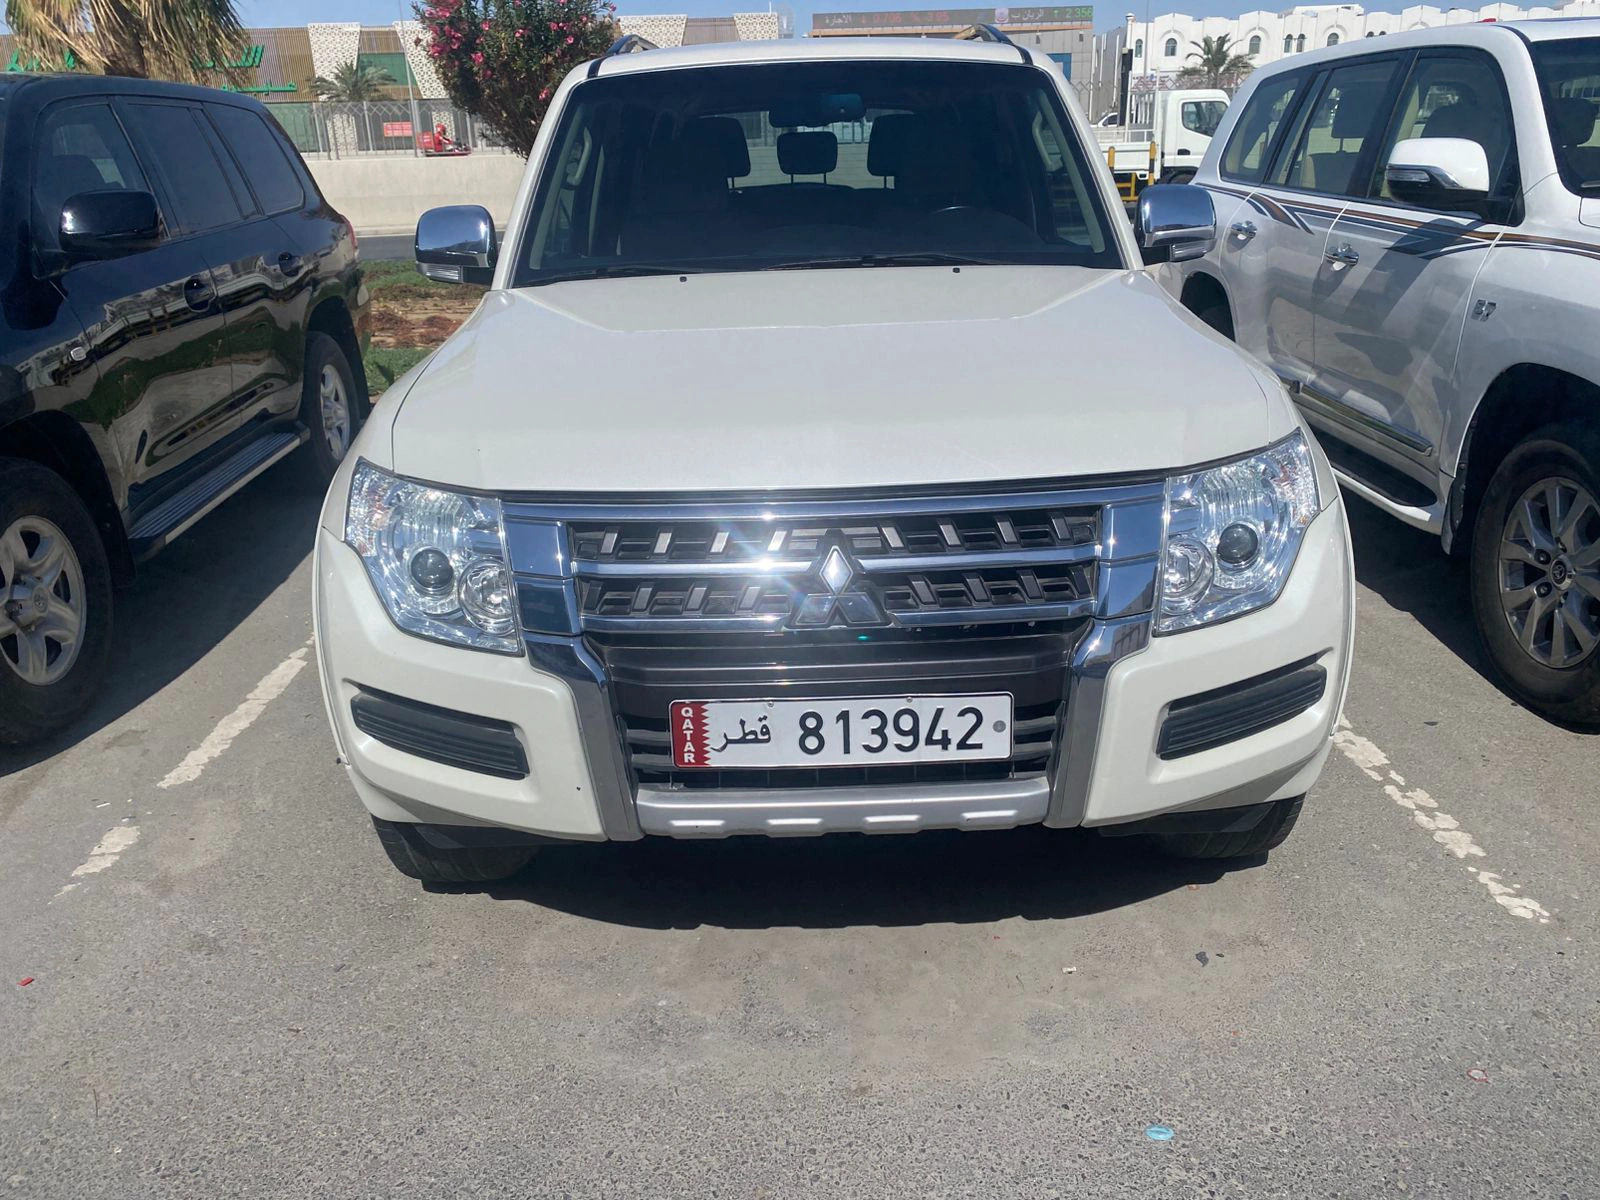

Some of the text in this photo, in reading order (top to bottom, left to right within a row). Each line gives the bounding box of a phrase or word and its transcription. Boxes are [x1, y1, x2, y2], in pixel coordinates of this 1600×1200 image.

[681, 707, 696, 763] QATAR
[710, 706, 984, 755] قطر 813942
